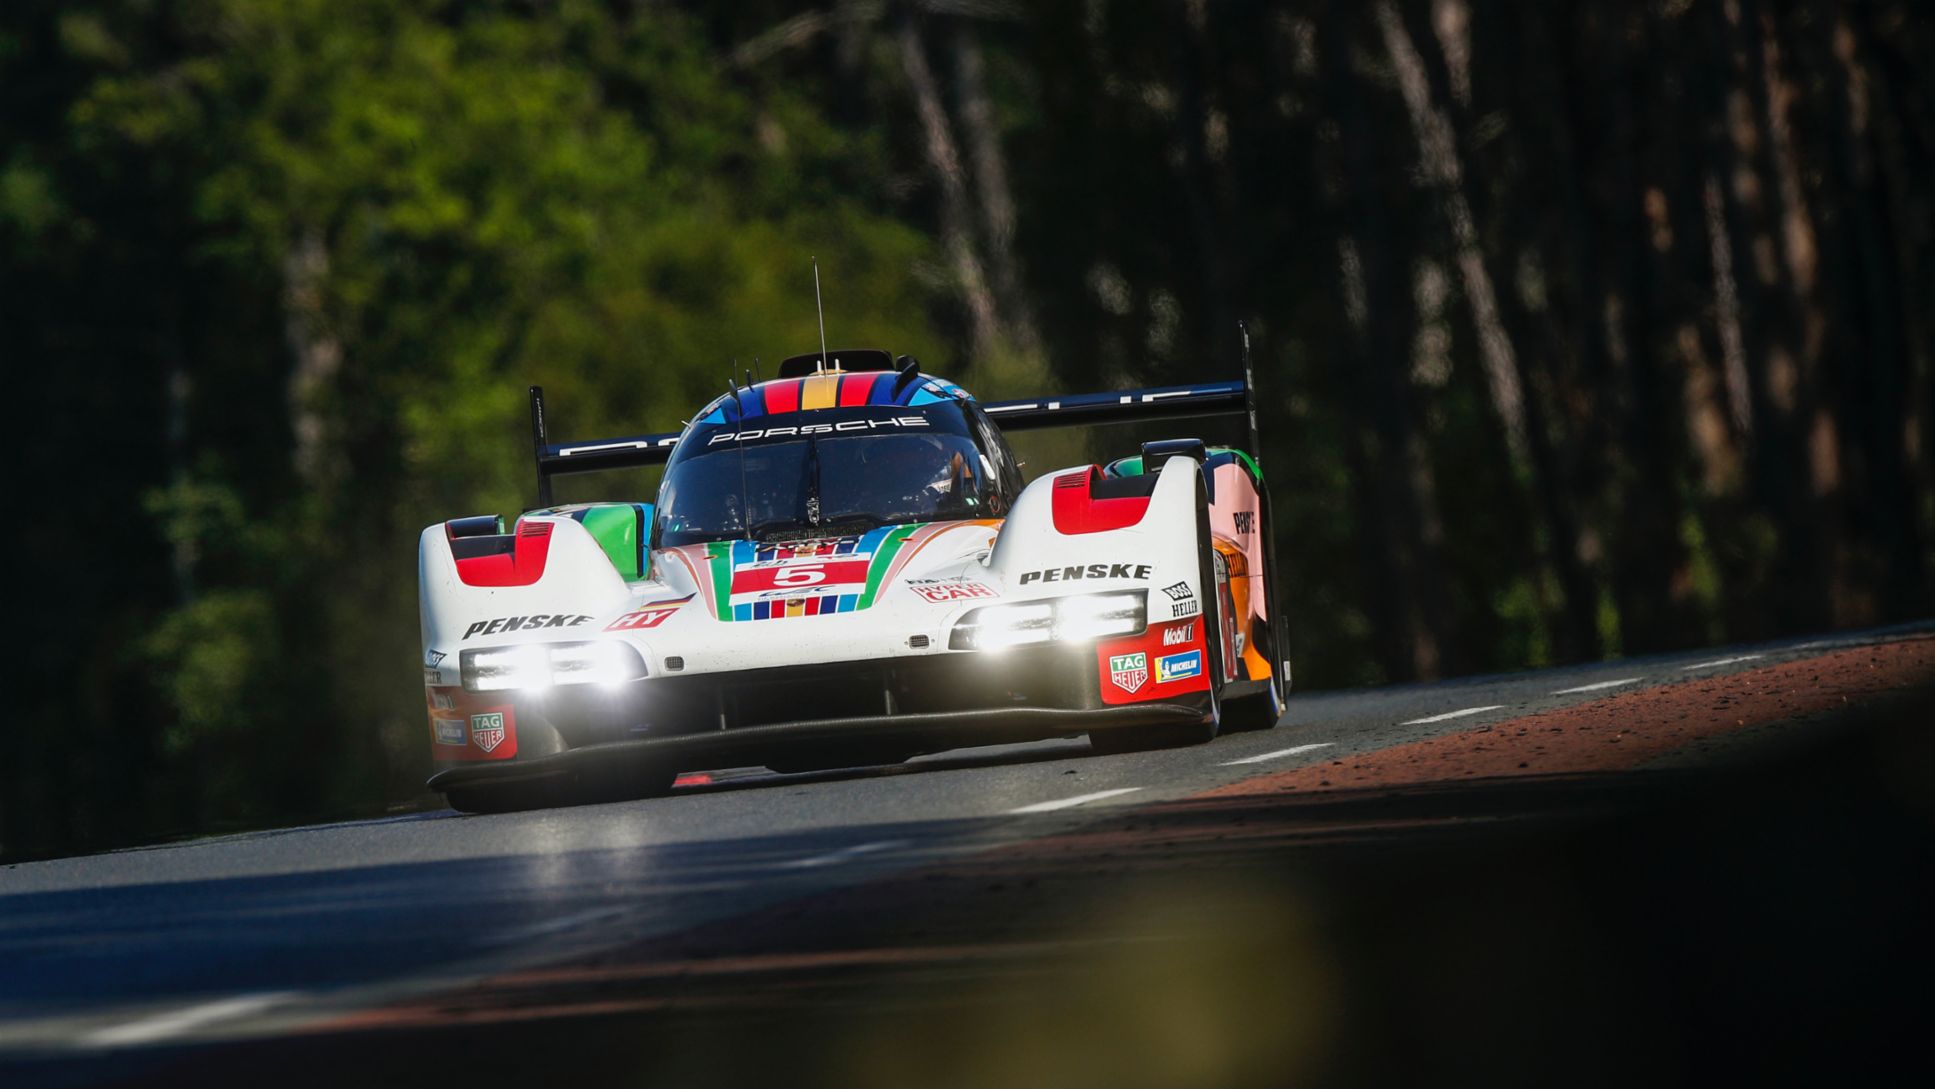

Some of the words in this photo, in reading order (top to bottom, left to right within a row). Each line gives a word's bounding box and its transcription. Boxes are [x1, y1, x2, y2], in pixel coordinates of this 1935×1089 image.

[708, 416, 931, 446] PORSCHE
[773, 564, 826, 586] 5
[1019, 564, 1153, 585] PENSKE
[926, 588, 992, 601] CAR
[1165, 583, 1192, 599] BOSS
[462, 615, 595, 640] PENSKE
[608, 610, 674, 627] HY
[1164, 625, 1187, 646] Mobil
[1113, 656, 1144, 670] TAG
[1114, 669, 1147, 690] HEUER
[474, 716, 501, 728] TAG
[475, 730, 502, 749] HEUER
